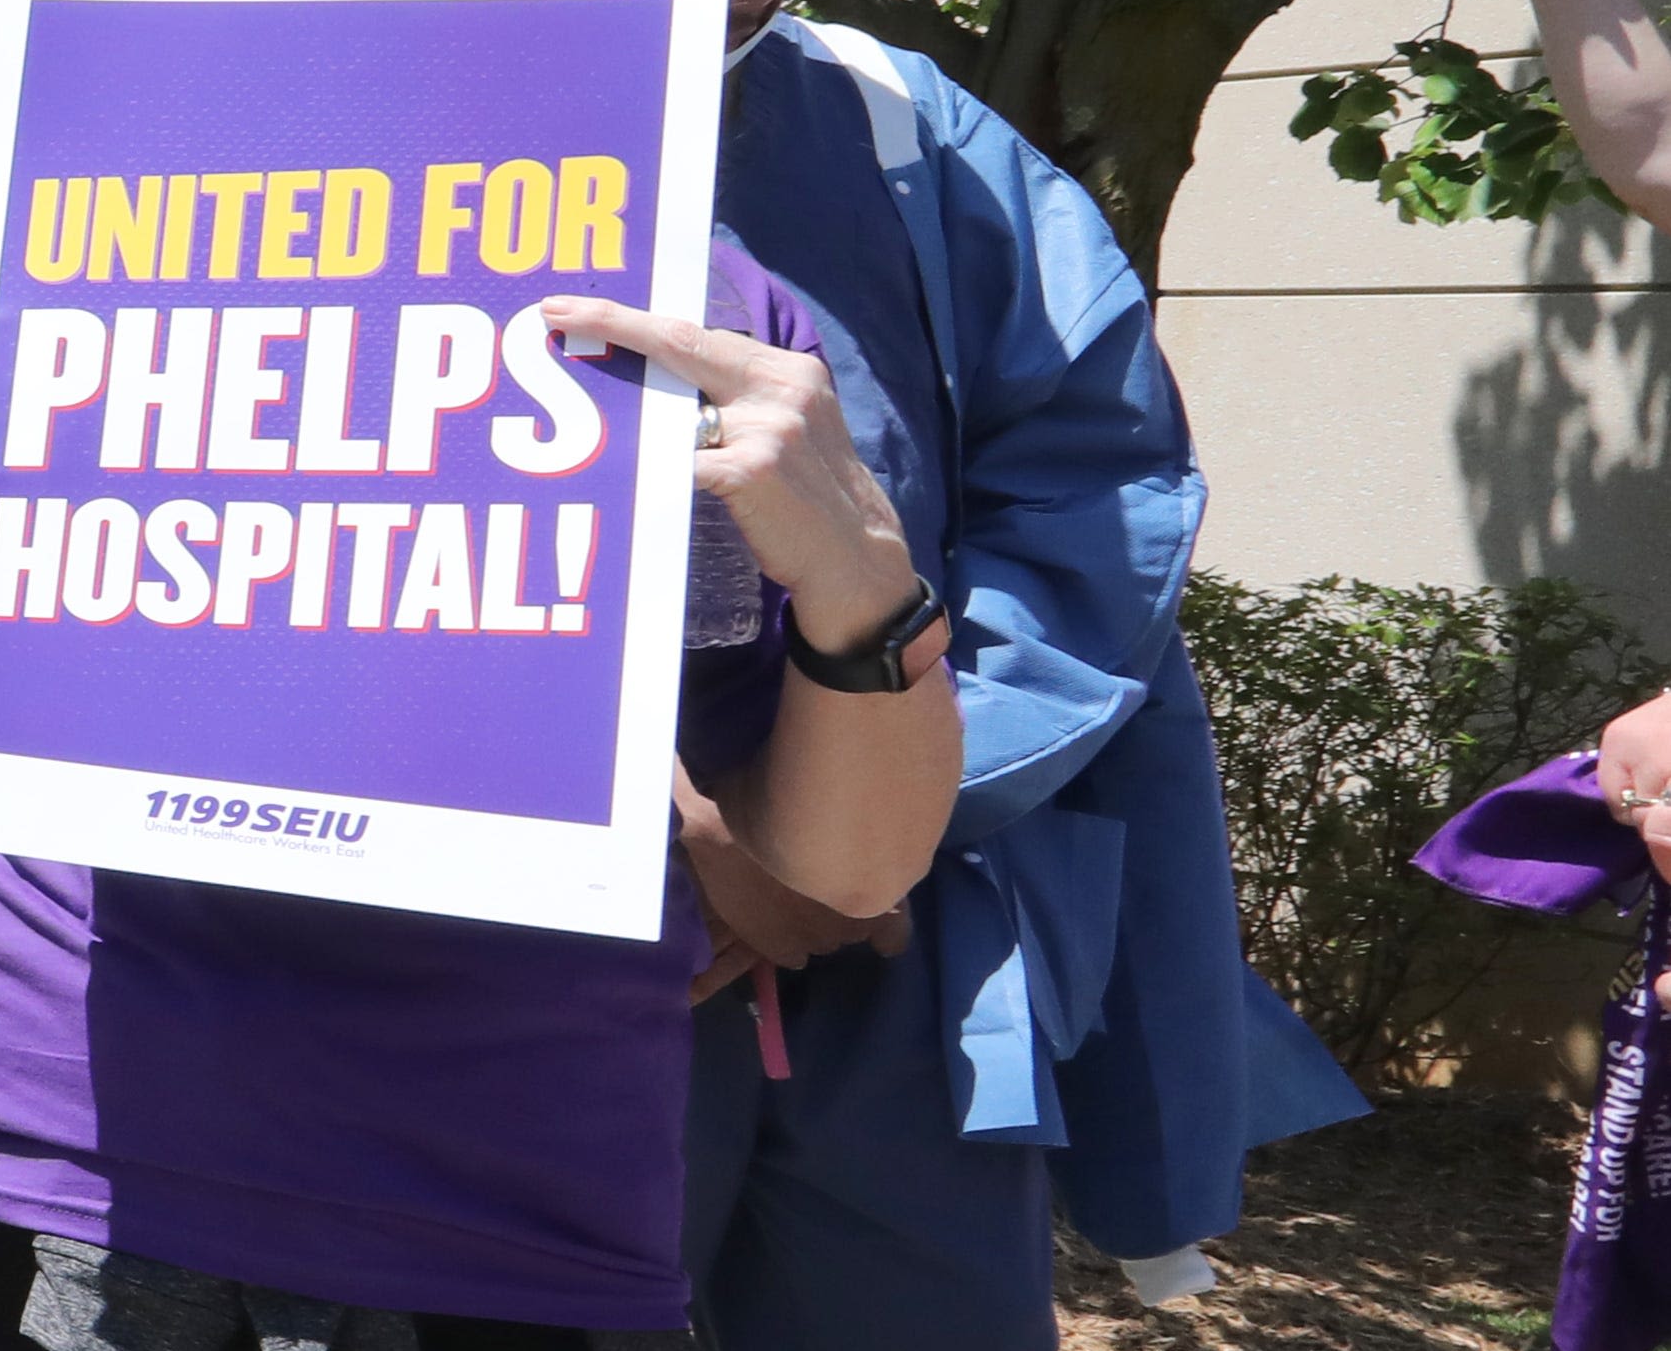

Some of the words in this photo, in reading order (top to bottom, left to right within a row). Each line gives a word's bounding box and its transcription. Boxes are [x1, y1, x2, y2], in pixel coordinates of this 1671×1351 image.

[24, 168, 392, 283] UNITED
[416, 155, 628, 276] FOR
[3, 296, 609, 476] PHELPS
[145, 820, 188, 836] United
[193, 826, 267, 846] Healthcare
[272, 835, 331, 855] Workers
[336, 844, 366, 859] East
[147, 790, 370, 842] 1199SEIU
[1601, 1040, 1646, 1145] STAND
[1598, 1146, 1628, 1187] UP
